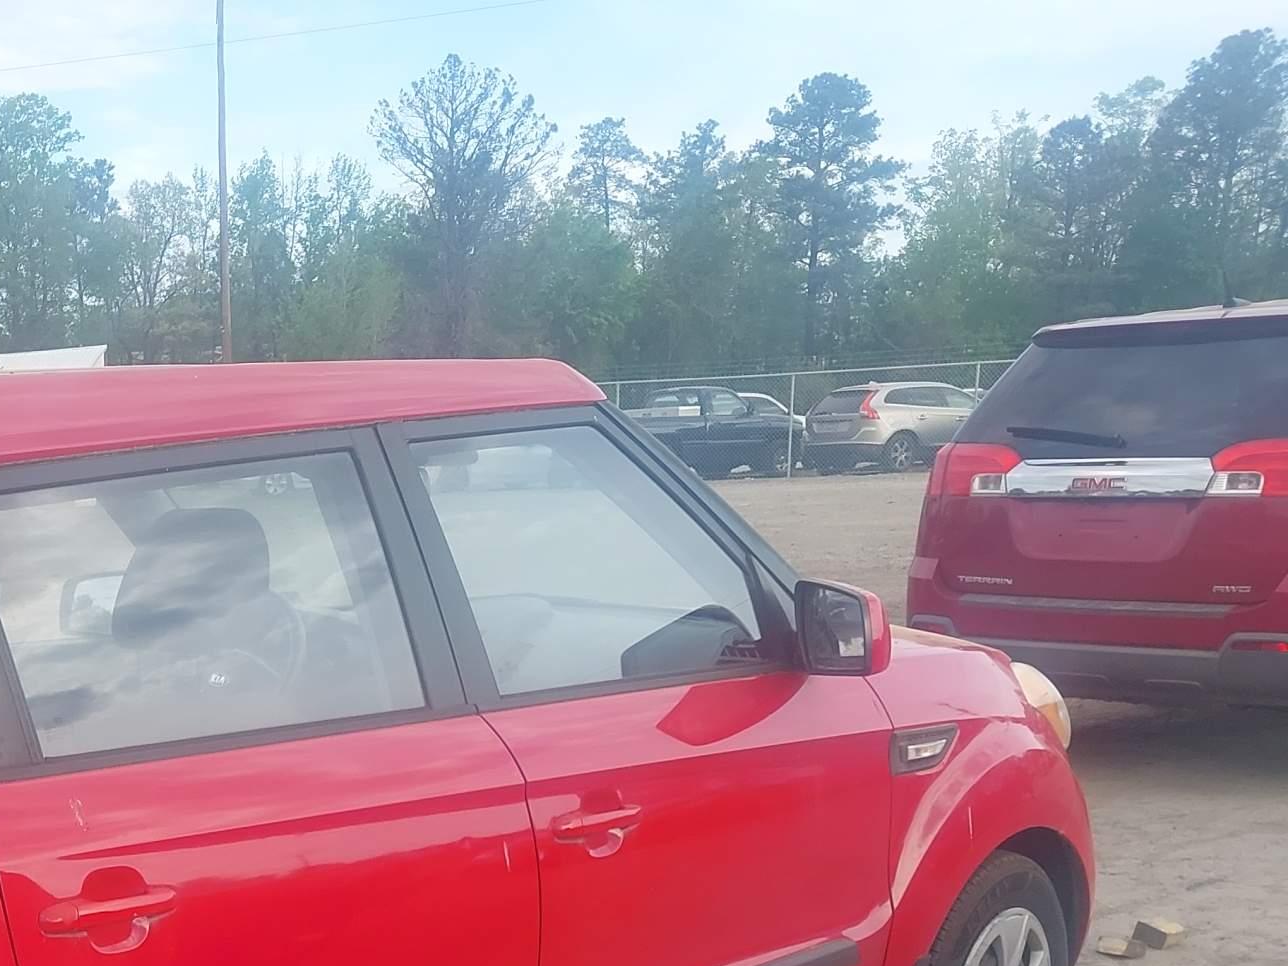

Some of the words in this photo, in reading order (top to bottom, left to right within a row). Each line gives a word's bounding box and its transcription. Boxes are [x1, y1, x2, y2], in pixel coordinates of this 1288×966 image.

[1072, 477, 1128, 490] GMC
[957, 575, 1014, 585] TERRAIN
[1212, 585, 1252, 593] AWD
